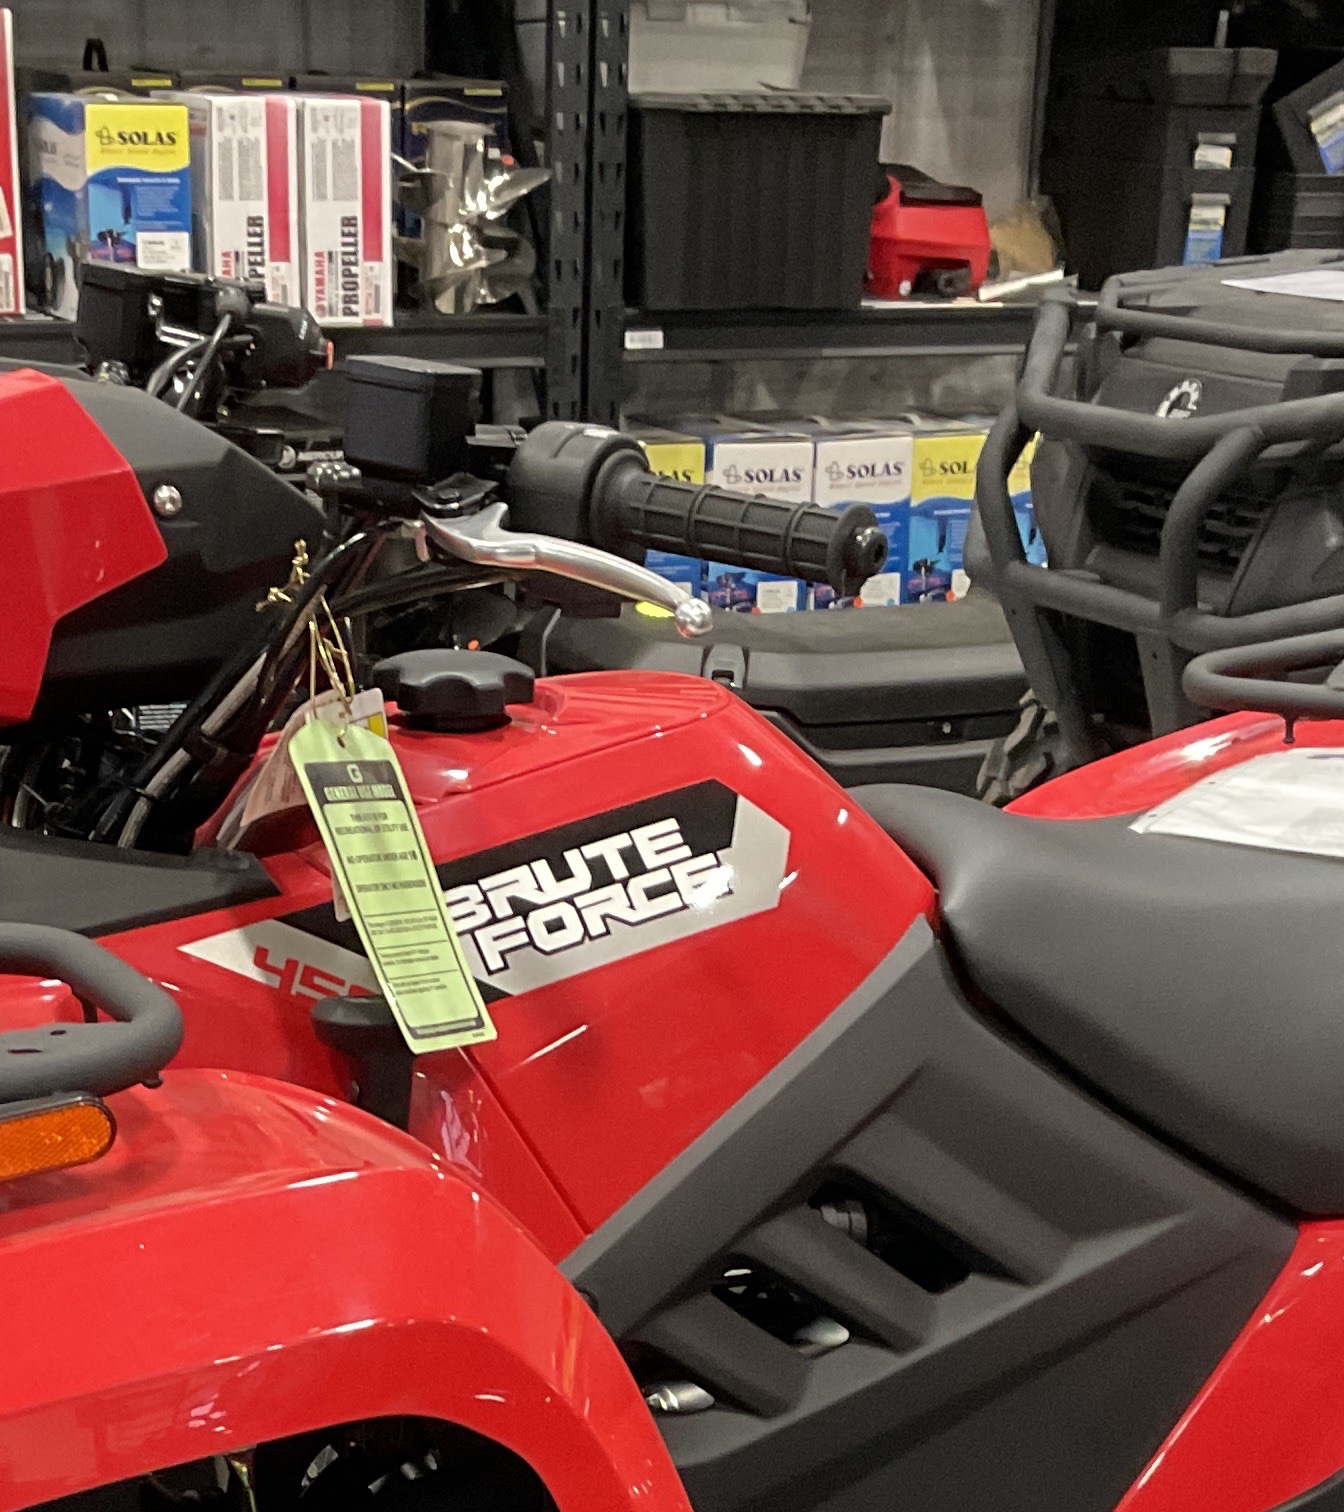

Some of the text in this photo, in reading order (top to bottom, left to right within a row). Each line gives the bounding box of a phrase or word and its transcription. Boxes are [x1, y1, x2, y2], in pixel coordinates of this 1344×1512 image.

[117, 130, 177, 147] SOLAS
[221, 251, 234, 277] AHA
[247, 216, 266, 278] PELLER
[340, 216, 360, 317] PROPELLER
[314, 251, 326, 303] YAMAHA
[744, 468, 803, 483] SOLAS
[846, 461, 904, 479] SOLAS
[939, 460, 975, 476] SOL
[444, 817, 693, 934] BRUTE
[473, 852, 735, 973] FORCE
